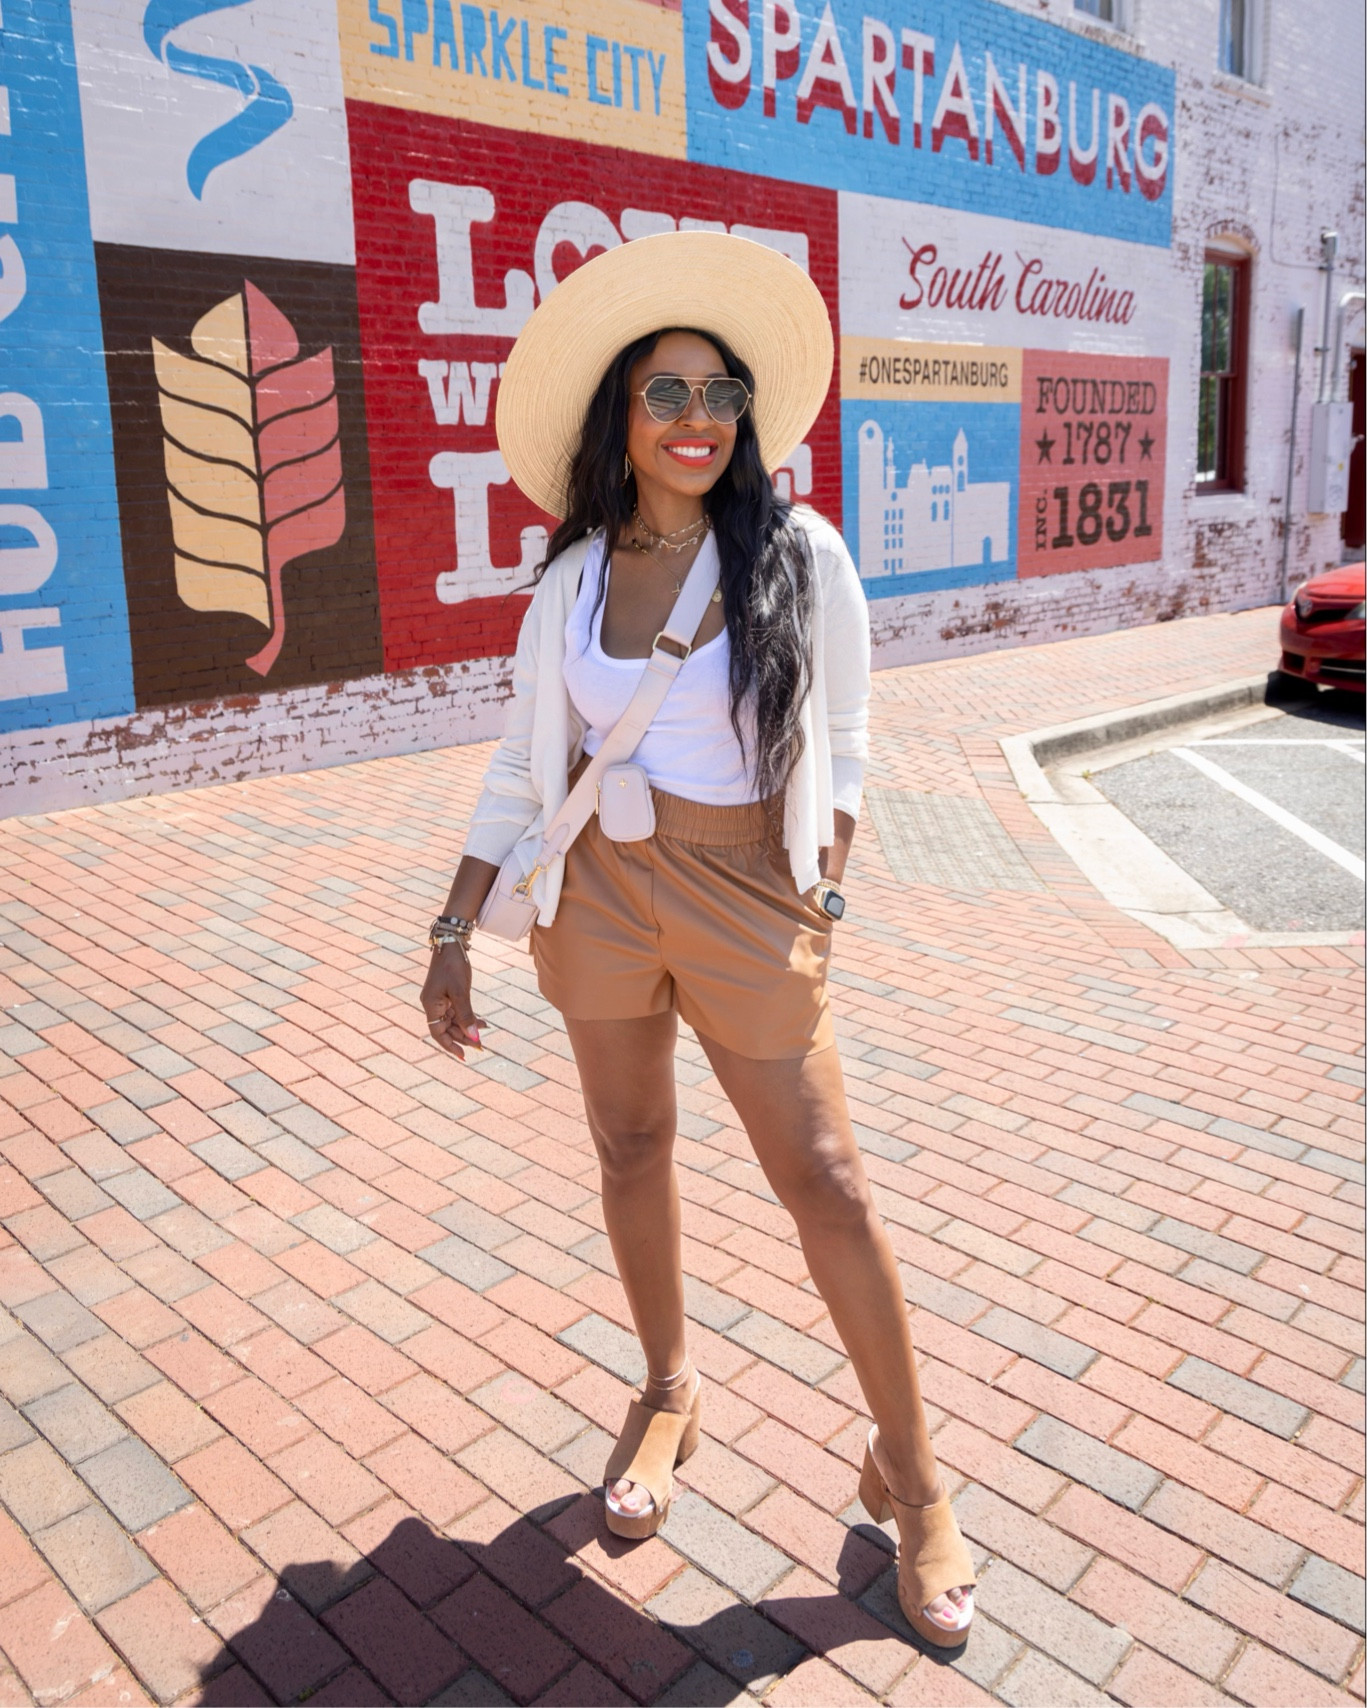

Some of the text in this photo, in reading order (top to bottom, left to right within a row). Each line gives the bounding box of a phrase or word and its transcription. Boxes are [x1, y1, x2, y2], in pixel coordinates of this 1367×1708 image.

[368, 0, 667, 116] SPARKLE CITY
[706, 0, 1169, 201] SPARTANBURG
[899, 236, 1137, 325] South Carolina
[859, 355, 1009, 388] #ONESPARTANBURG
[1036, 376, 1157, 416] FOUNDED
[1062, 420, 1132, 465] 1787
[1035, 479, 1153, 552] INC. 1831
